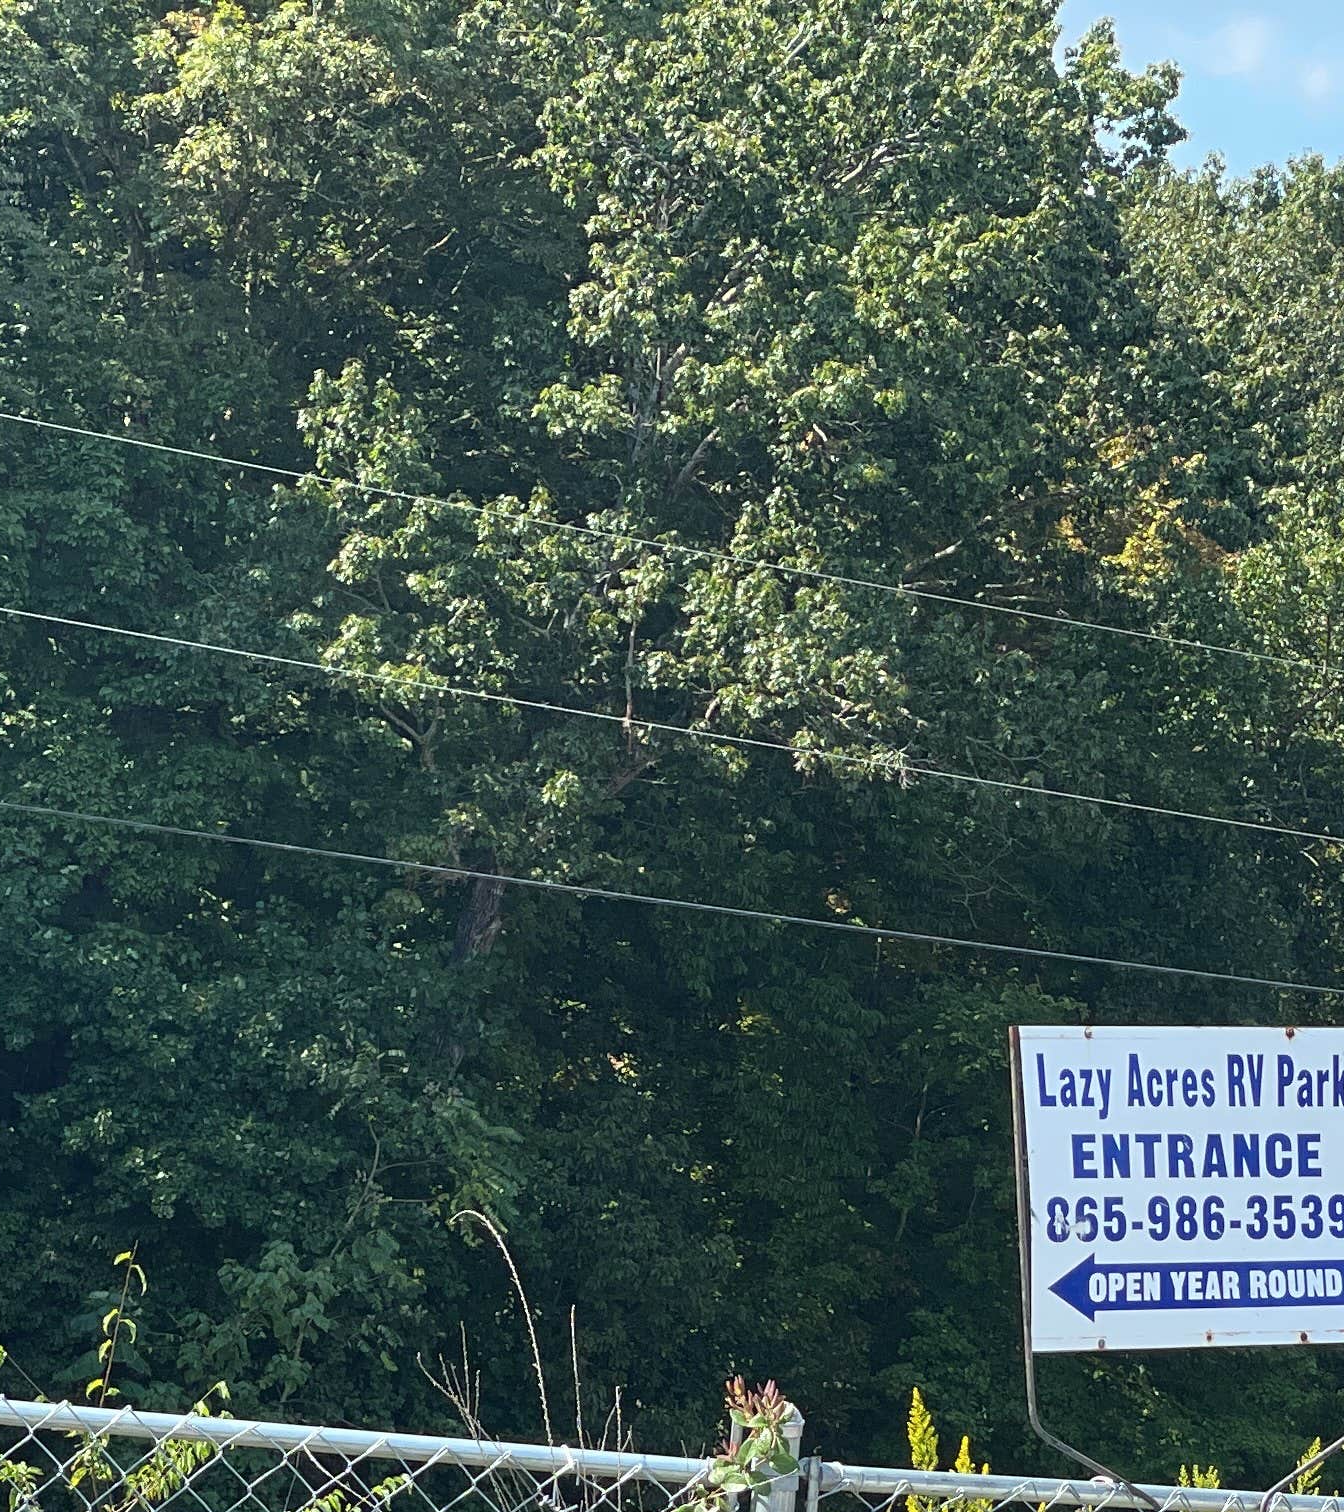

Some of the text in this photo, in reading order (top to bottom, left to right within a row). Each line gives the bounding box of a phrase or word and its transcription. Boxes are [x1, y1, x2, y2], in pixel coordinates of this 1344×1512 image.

[1036, 1053, 1112, 1119] Lazy
[1127, 1053, 1216, 1108] Acres
[1227, 1054, 1264, 1107] RV
[1071, 1133, 1322, 1179] ENTRANCE
[1088, 1268, 1343, 1303] OPEN YEAR ROUND
